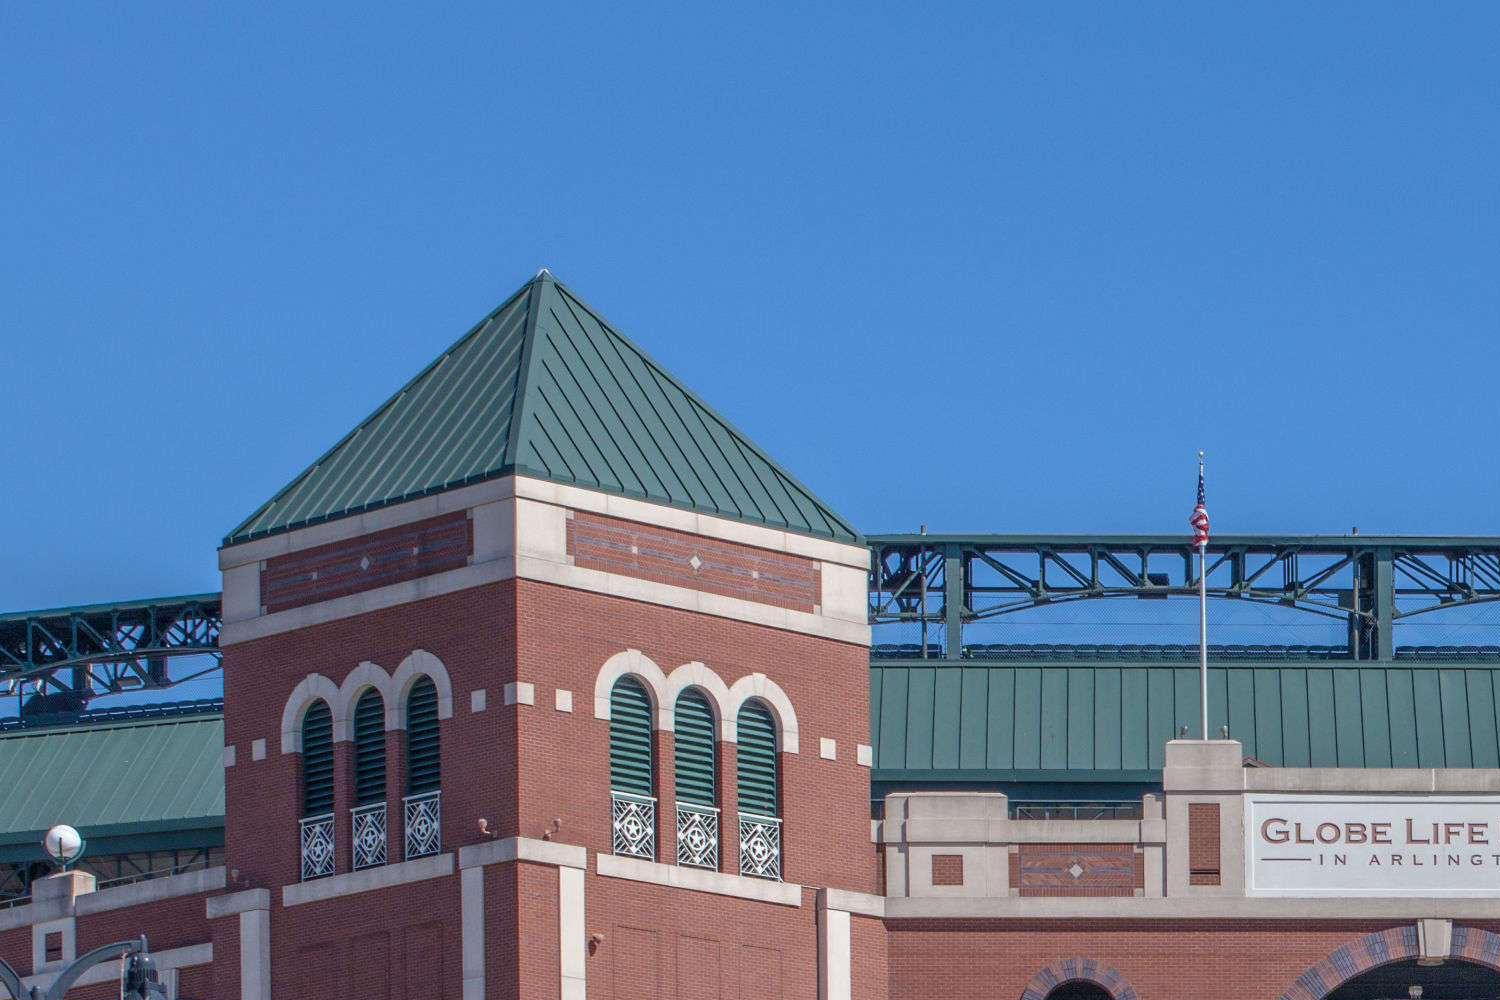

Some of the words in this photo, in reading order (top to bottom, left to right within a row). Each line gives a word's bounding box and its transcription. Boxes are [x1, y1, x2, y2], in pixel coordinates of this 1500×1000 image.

[1260, 817, 1393, 845] GLOBE
[1405, 817, 1489, 845] LIFE
[1320, 854, 1347, 866] IN
